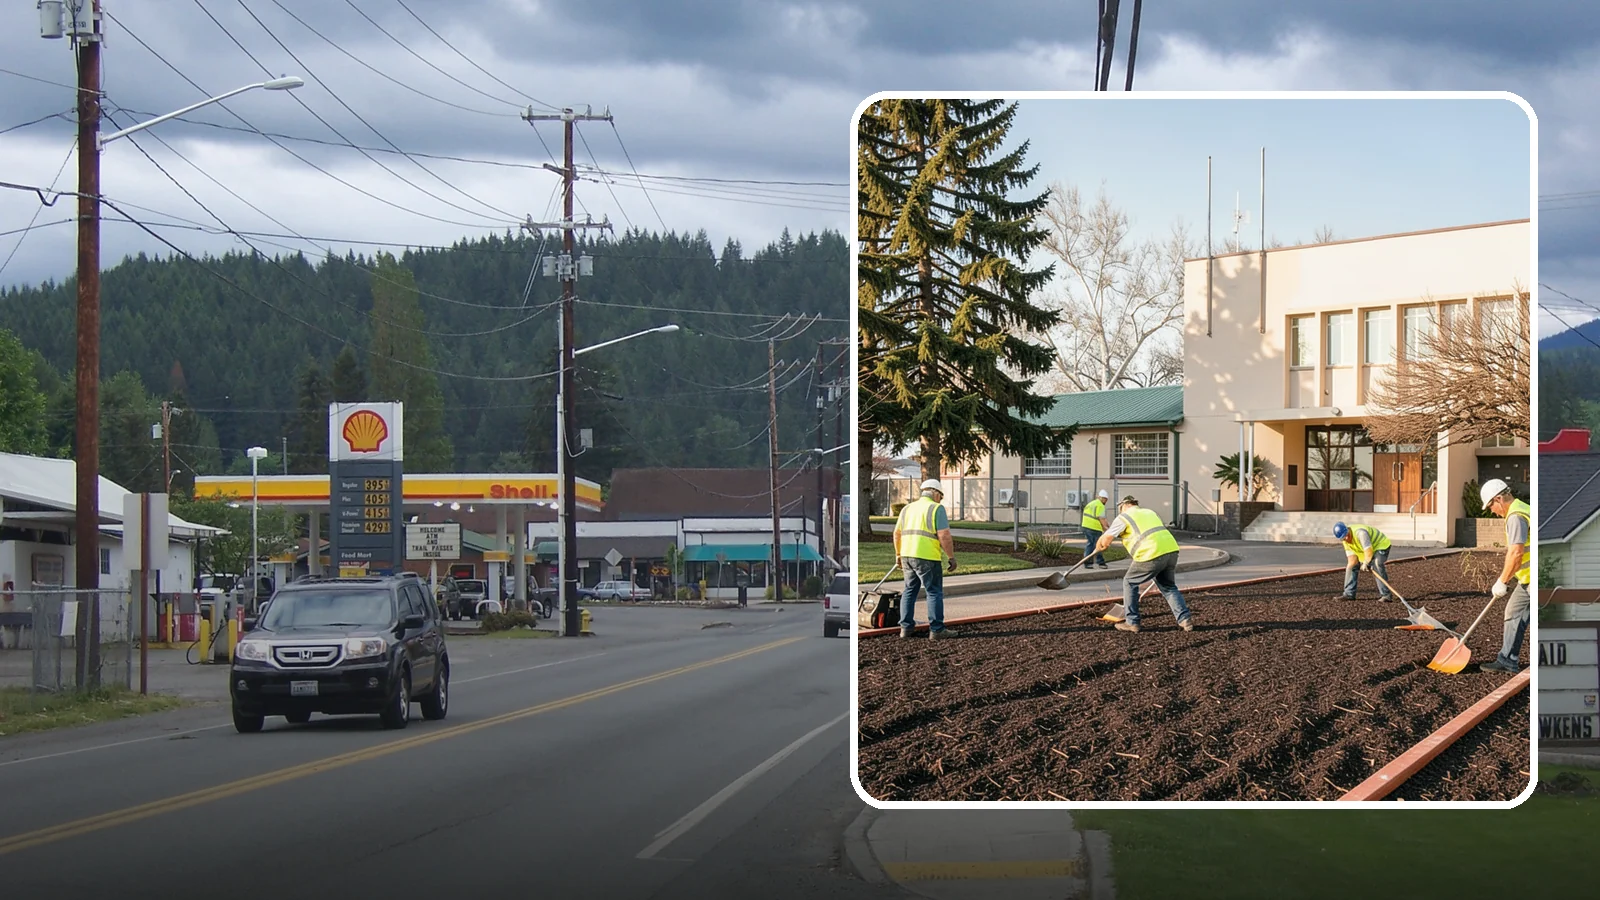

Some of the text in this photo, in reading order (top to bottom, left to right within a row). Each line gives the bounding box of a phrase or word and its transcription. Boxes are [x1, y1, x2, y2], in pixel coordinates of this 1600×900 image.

[365, 480, 383, 490] 395
[490, 484, 547, 499] Shell
[365, 494, 383, 504] 405
[365, 508, 383, 518] 415
[365, 522, 383, 532] 429
